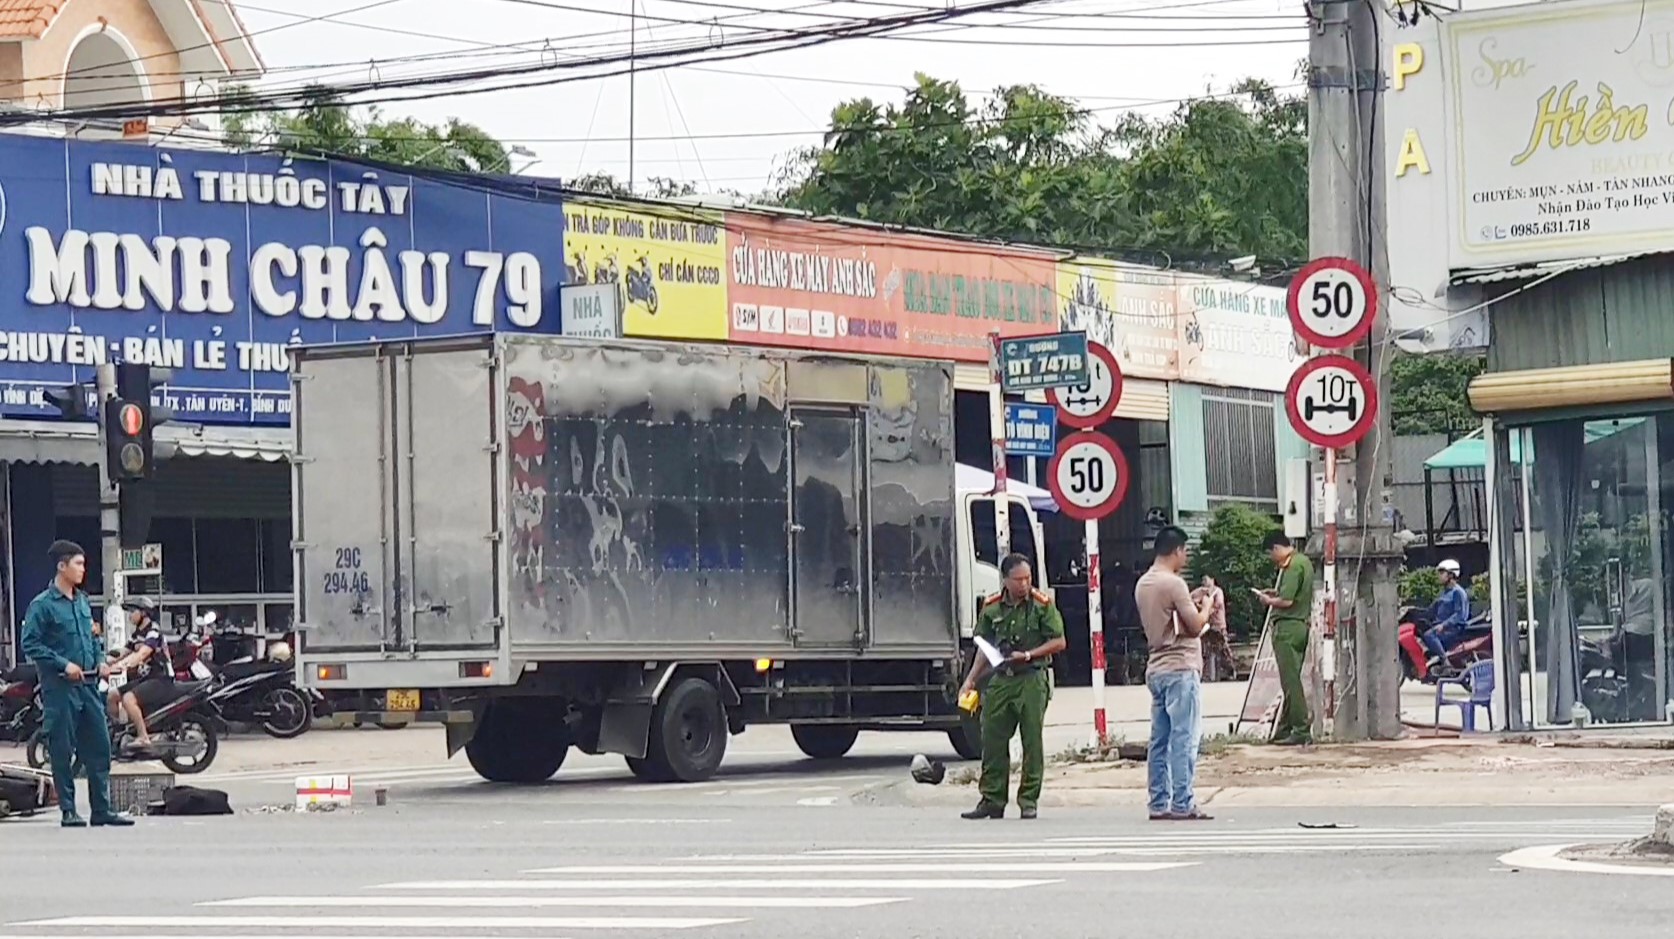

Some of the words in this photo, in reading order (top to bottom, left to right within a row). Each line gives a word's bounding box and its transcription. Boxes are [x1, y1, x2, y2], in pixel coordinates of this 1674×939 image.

[1510, 80, 1649, 166] Hiền
[90, 153, 183, 200] NHÀ
[193, 158, 326, 210] THUỐC
[337, 172, 409, 214] TÂY
[1633, 193, 1659, 210] Học
[1510, 217, 1591, 237] 0985.631.718
[25, 226, 232, 313] MINH
[250, 226, 450, 323] CHÂU
[464, 250, 543, 327] 79
[757, 238, 789, 289] HÀNG
[789, 251, 806, 290] XE
[805, 244, 830, 293] MÁY
[832, 257, 855, 296] ANH
[1121, 296, 1148, 326] ANH
[1219, 287, 1250, 314] HÀNG
[1253, 296, 1267, 317] XE
[1270, 294, 1288, 320] MÁ
[1311, 281, 1354, 319] 50
[123, 325, 184, 368] BÁN
[193, 325, 227, 370] LẺ
[1038, 353, 1082, 374] 747B
[1070, 456, 1104, 494] 50
[335, 547, 361, 569] 29C
[324, 572, 369, 594] 294.46
